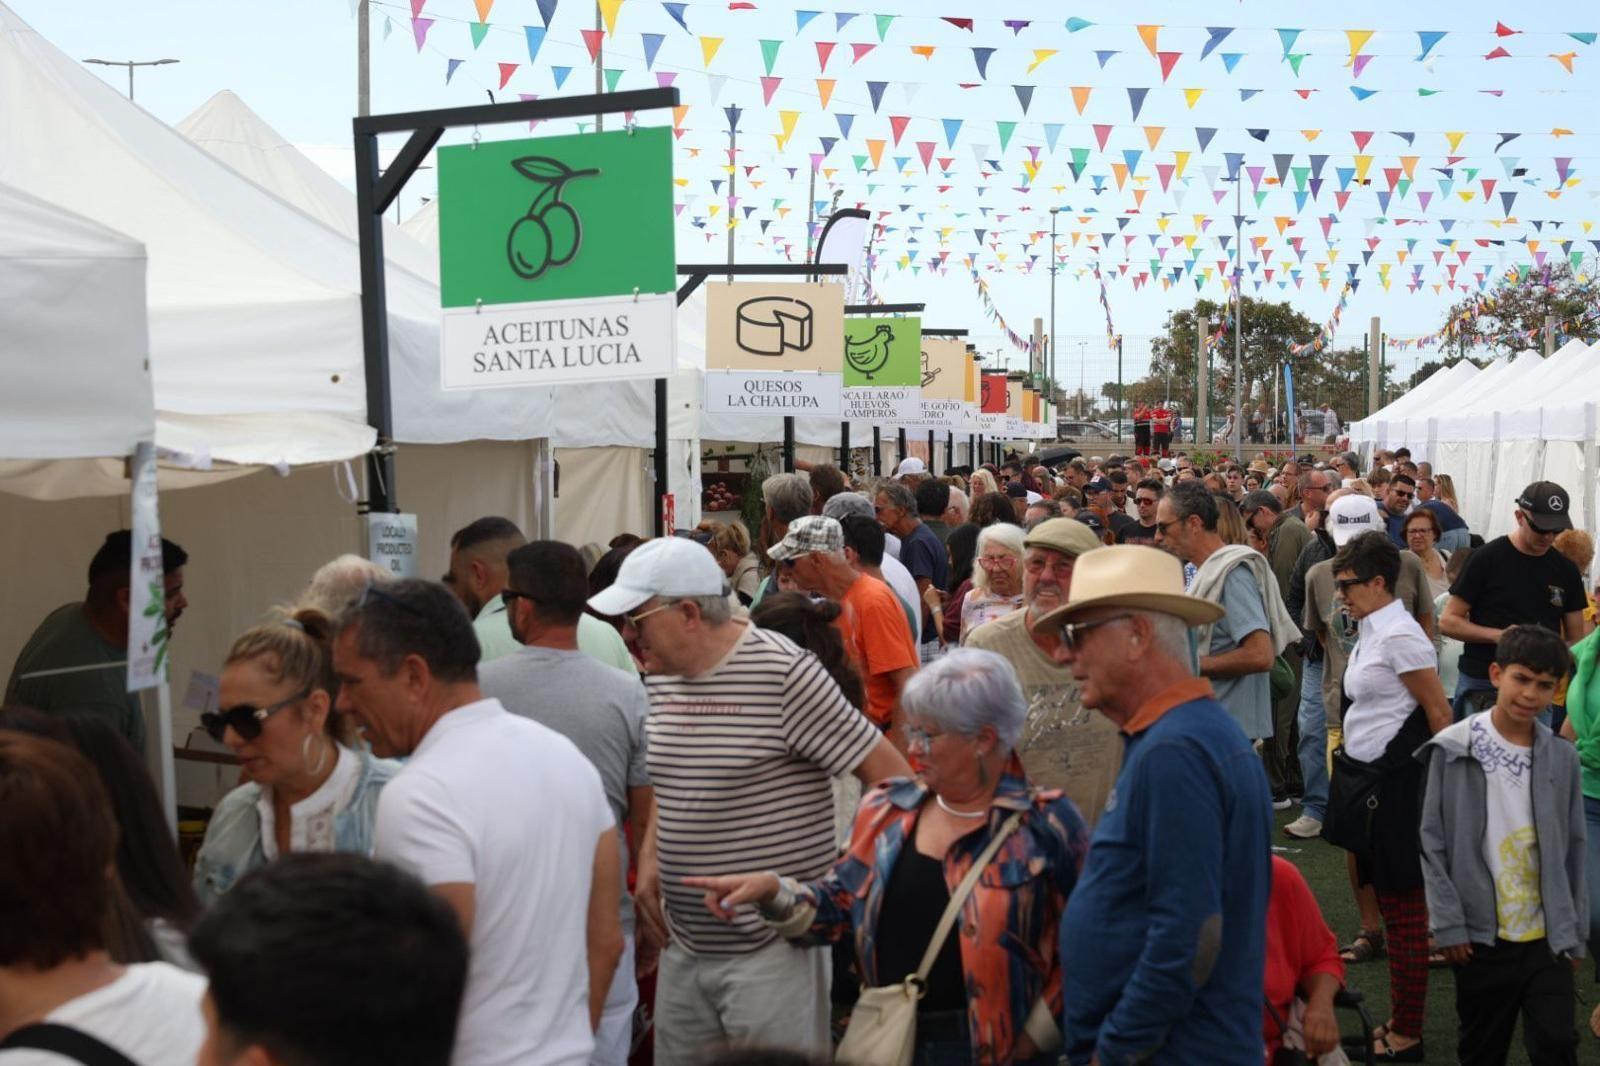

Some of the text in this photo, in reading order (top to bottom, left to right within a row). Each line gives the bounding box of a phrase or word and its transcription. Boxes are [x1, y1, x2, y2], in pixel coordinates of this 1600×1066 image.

[482, 314, 629, 346] ACEITUNAS
[473, 342, 642, 373] SANTA LUCIA
[744, 379, 803, 394] QUESOS
[842, 391, 861, 400] NCA
[862, 391, 874, 399] EL
[876, 390, 905, 400] ARAO
[727, 394, 820, 408] LA CHALUPA
[850, 400, 891, 409] HUEVOS
[930, 402, 960, 411] GOFIO
[843, 409, 898, 418] CAMPEROS
[920, 410, 944, 419] DRO
